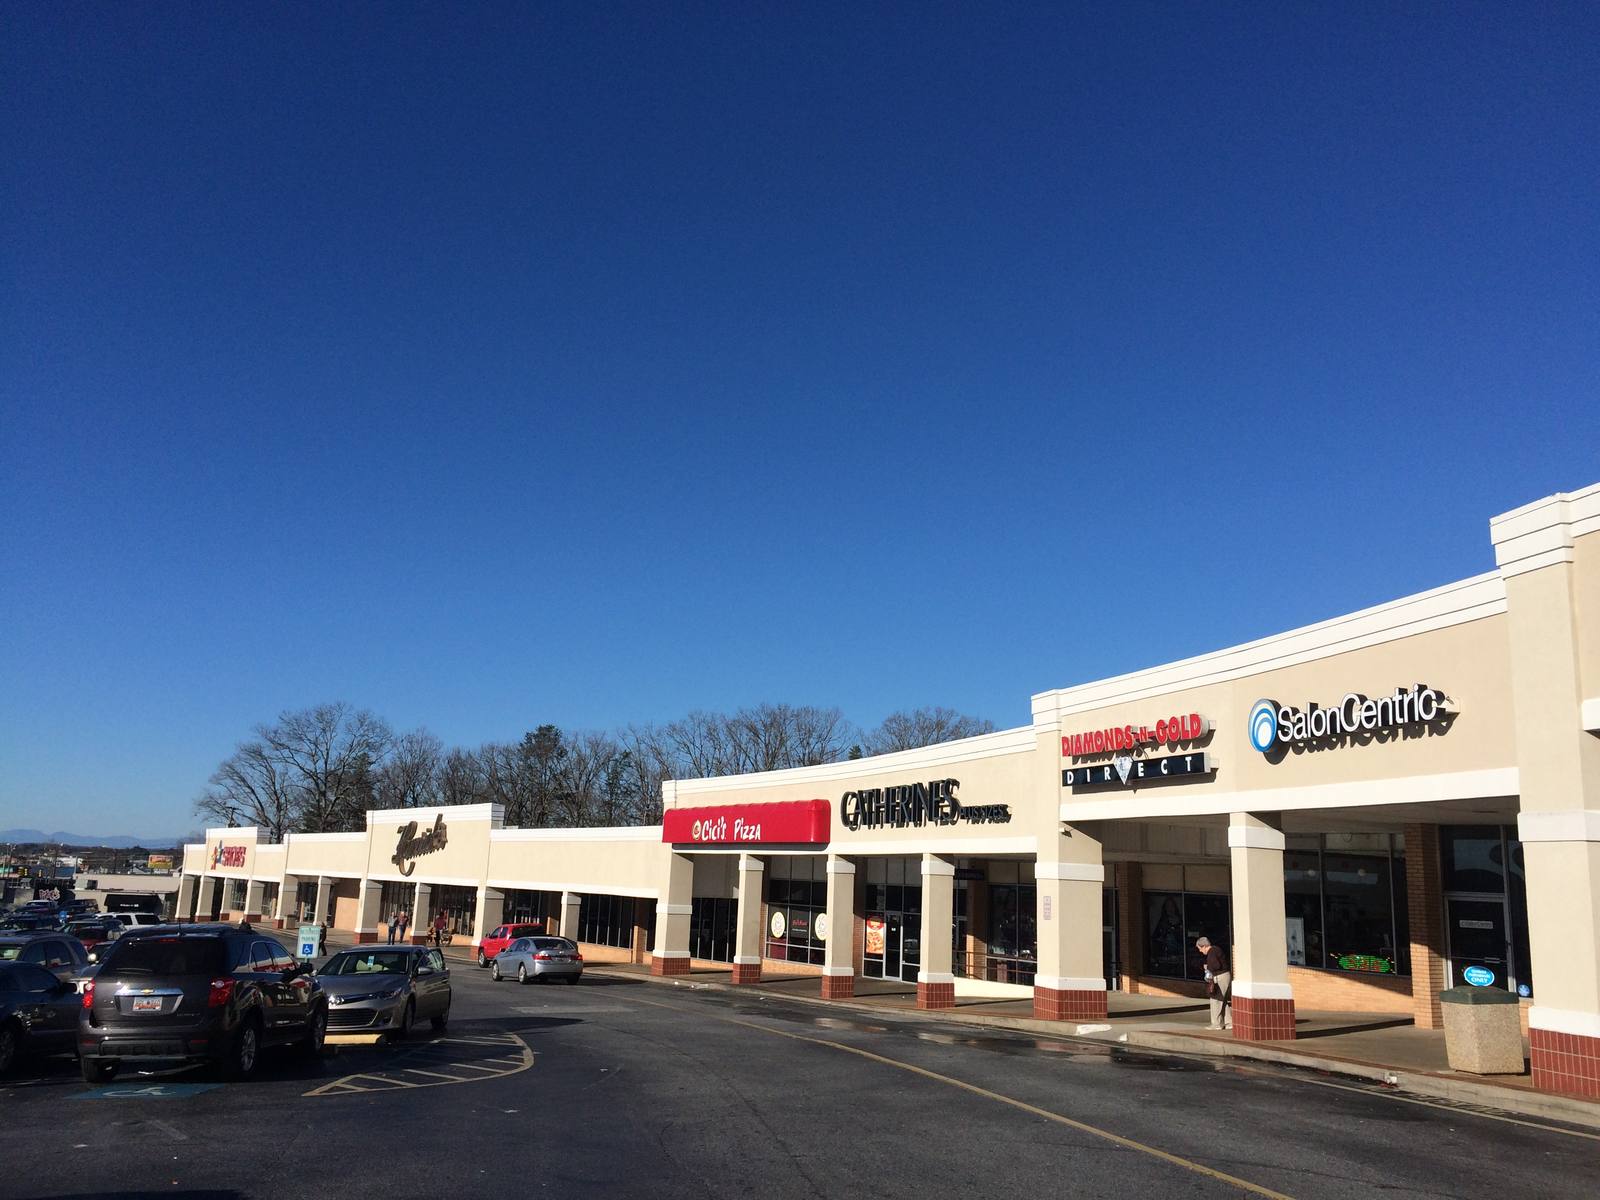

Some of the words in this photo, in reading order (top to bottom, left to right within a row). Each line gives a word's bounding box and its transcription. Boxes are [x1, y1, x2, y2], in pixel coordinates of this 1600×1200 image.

[1277, 683, 1437, 742] SalonCentric
[1066, 756, 1192, 784] DIRECT
[840, 778, 960, 829] CATHERINES
